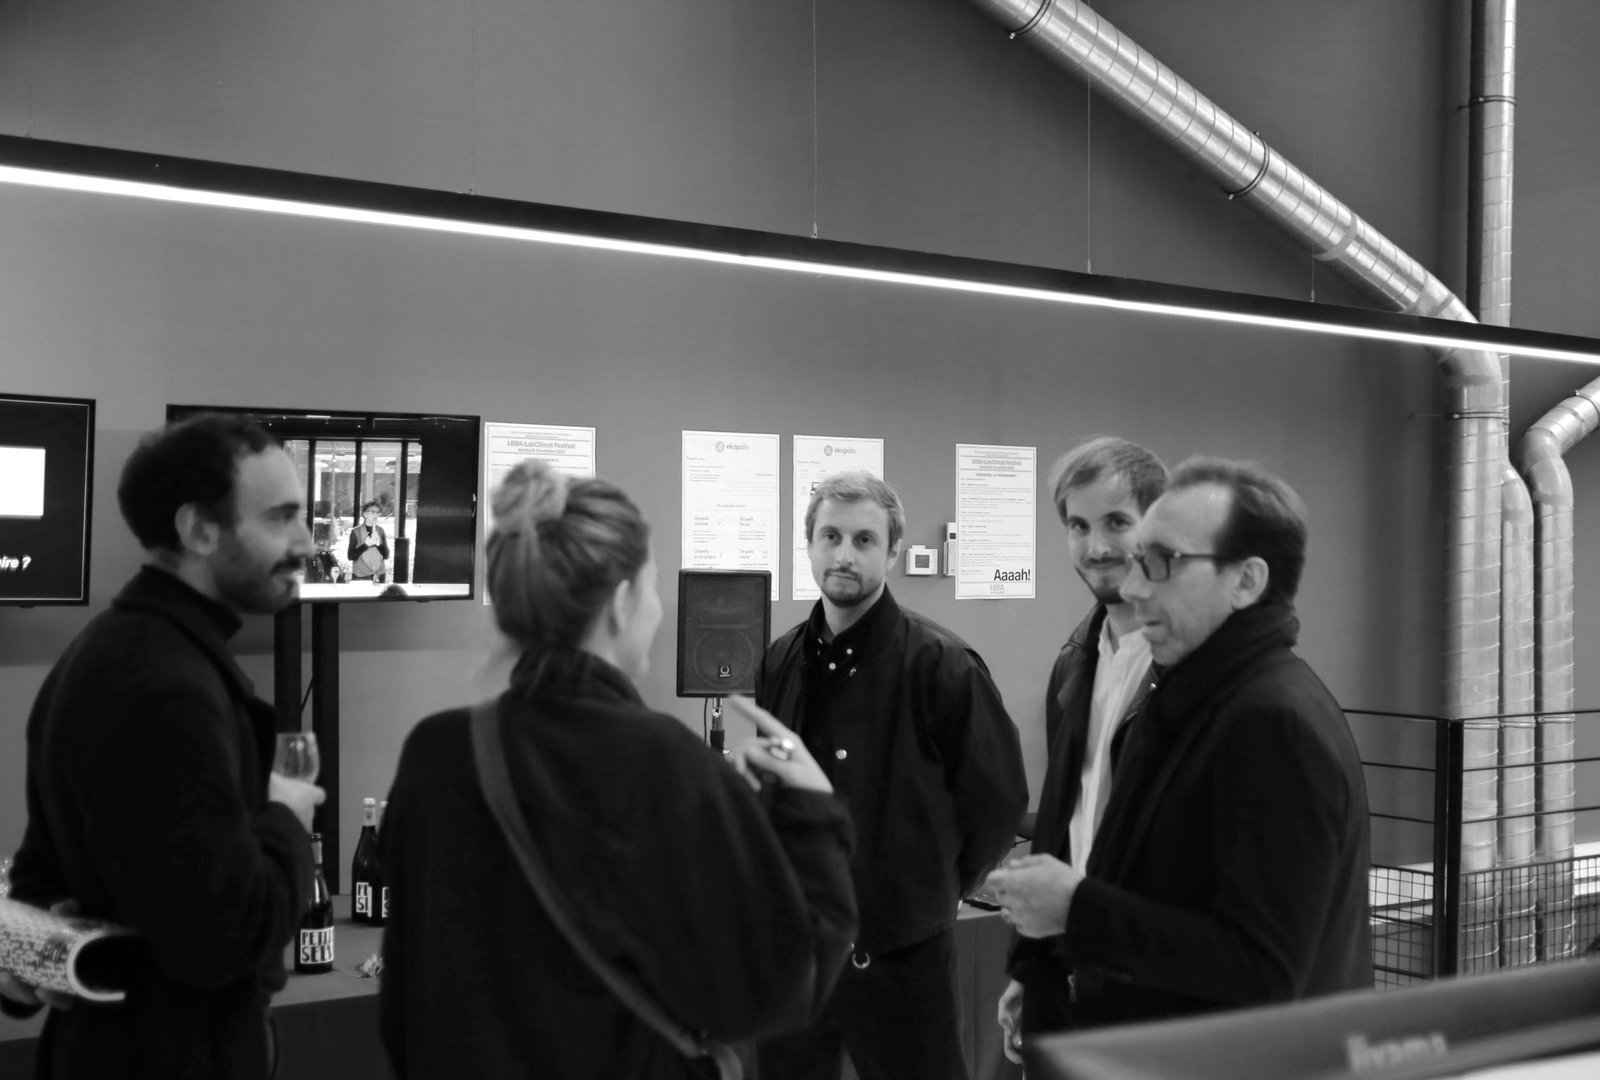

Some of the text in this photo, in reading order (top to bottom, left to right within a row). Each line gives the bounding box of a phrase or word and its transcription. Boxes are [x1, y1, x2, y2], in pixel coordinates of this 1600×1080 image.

[726, 442, 750, 451] ekopolis
[834, 446, 856, 455] ekopolis
[994, 568, 1031, 581] Aaaah!
